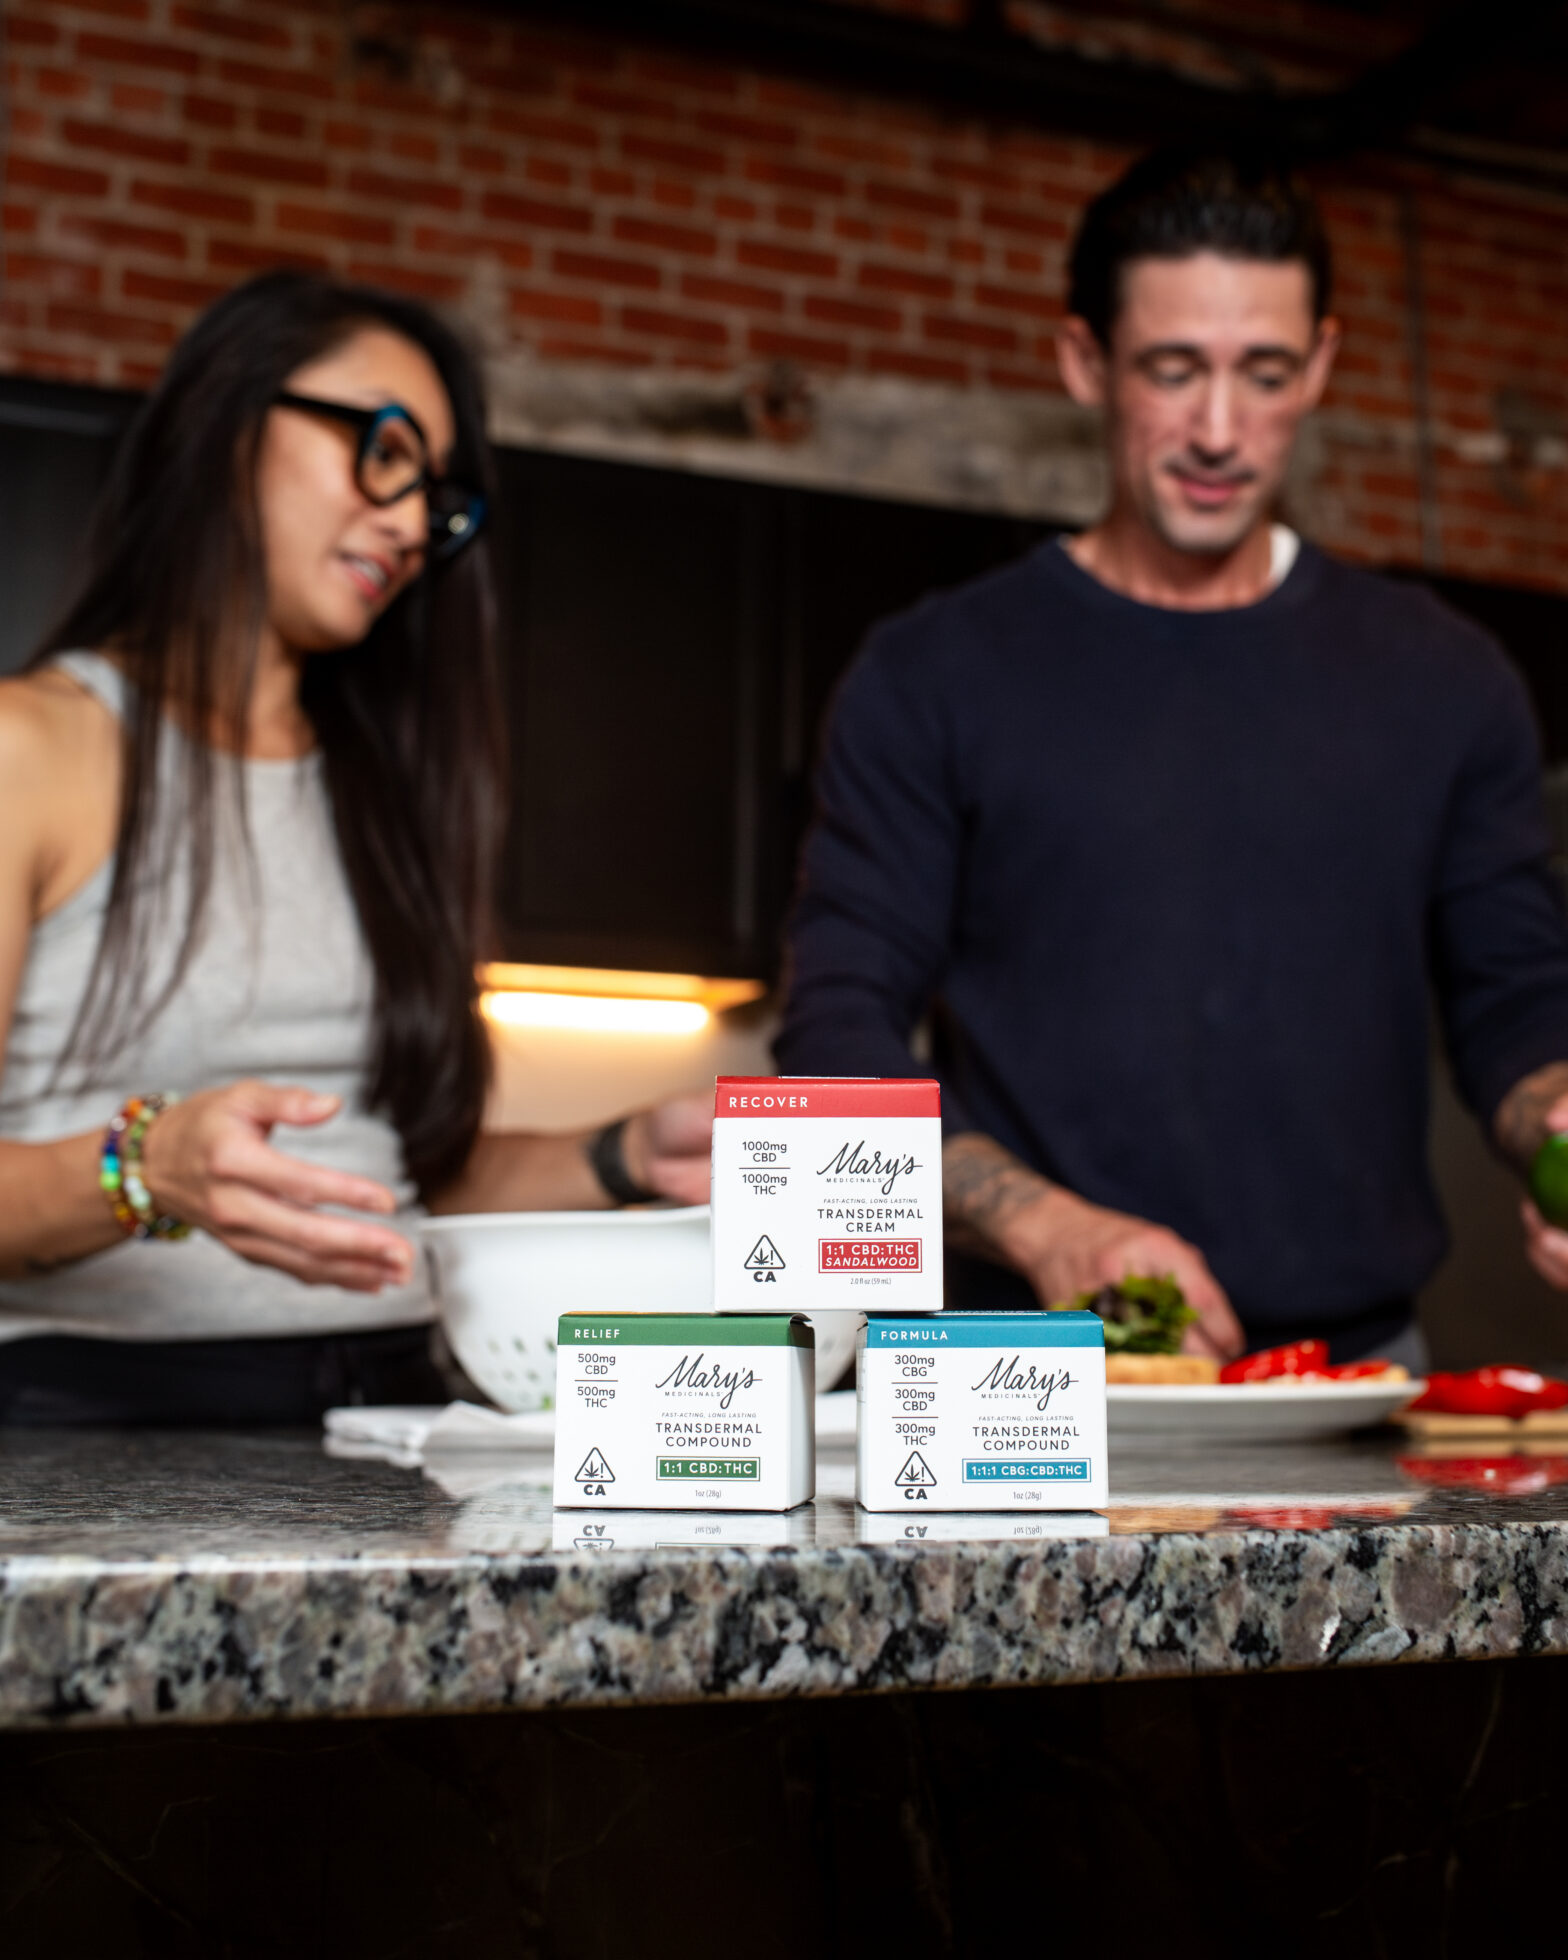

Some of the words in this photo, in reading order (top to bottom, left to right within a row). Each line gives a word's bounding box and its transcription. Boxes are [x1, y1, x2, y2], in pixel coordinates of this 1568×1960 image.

[729, 1096, 808, 1108] RECOVER
[742, 1141, 787, 1153] 1000mg
[753, 1153, 776, 1162] CBD
[816, 1140, 923, 1195] Mary's
[742, 1174, 787, 1186] 1000mg
[753, 1186, 776, 1195] THC
[817, 1208, 924, 1219] TRANSDERMAL
[846, 1222, 895, 1232] CREAM
[826, 1244, 844, 1255] 1:1
[851, 1244, 914, 1255] CBD:THC
[825, 1257, 917, 1267] SANDALWOOD
[753, 1271, 776, 1282] CA
[574, 1329, 620, 1338] RELIEF
[881, 1331, 948, 1340] FORMULA
[577, 1353, 616, 1366] 500mg
[894, 1355, 935, 1367] 300mg
[585, 1365, 608, 1375] CBD
[902, 1367, 927, 1377] CBG
[655, 1353, 763, 1410] Mary's
[971, 1355, 1079, 1411] Mary's
[577, 1386, 616, 1399] 500mg
[894, 1389, 935, 1401] 300mg
[585, 1399, 608, 1408] THC
[902, 1401, 927, 1411] CBD
[655, 1423, 762, 1434] TRANSDERMAL
[895, 1424, 936, 1436] 300mg
[972, 1426, 1080, 1437] TRANSDERMAL
[665, 1437, 752, 1448] COMPOUND
[903, 1436, 928, 1446] THC
[983, 1440, 1069, 1451] COMPOUND
[663, 1462, 683, 1473] 1:1
[689, 1462, 753, 1474] CBD:THC
[971, 1466, 997, 1476] 1:1:1
[1001, 1465, 1083, 1476] CBG:CBD:THC
[583, 1484, 606, 1496] CA
[904, 1488, 928, 1500] CA
